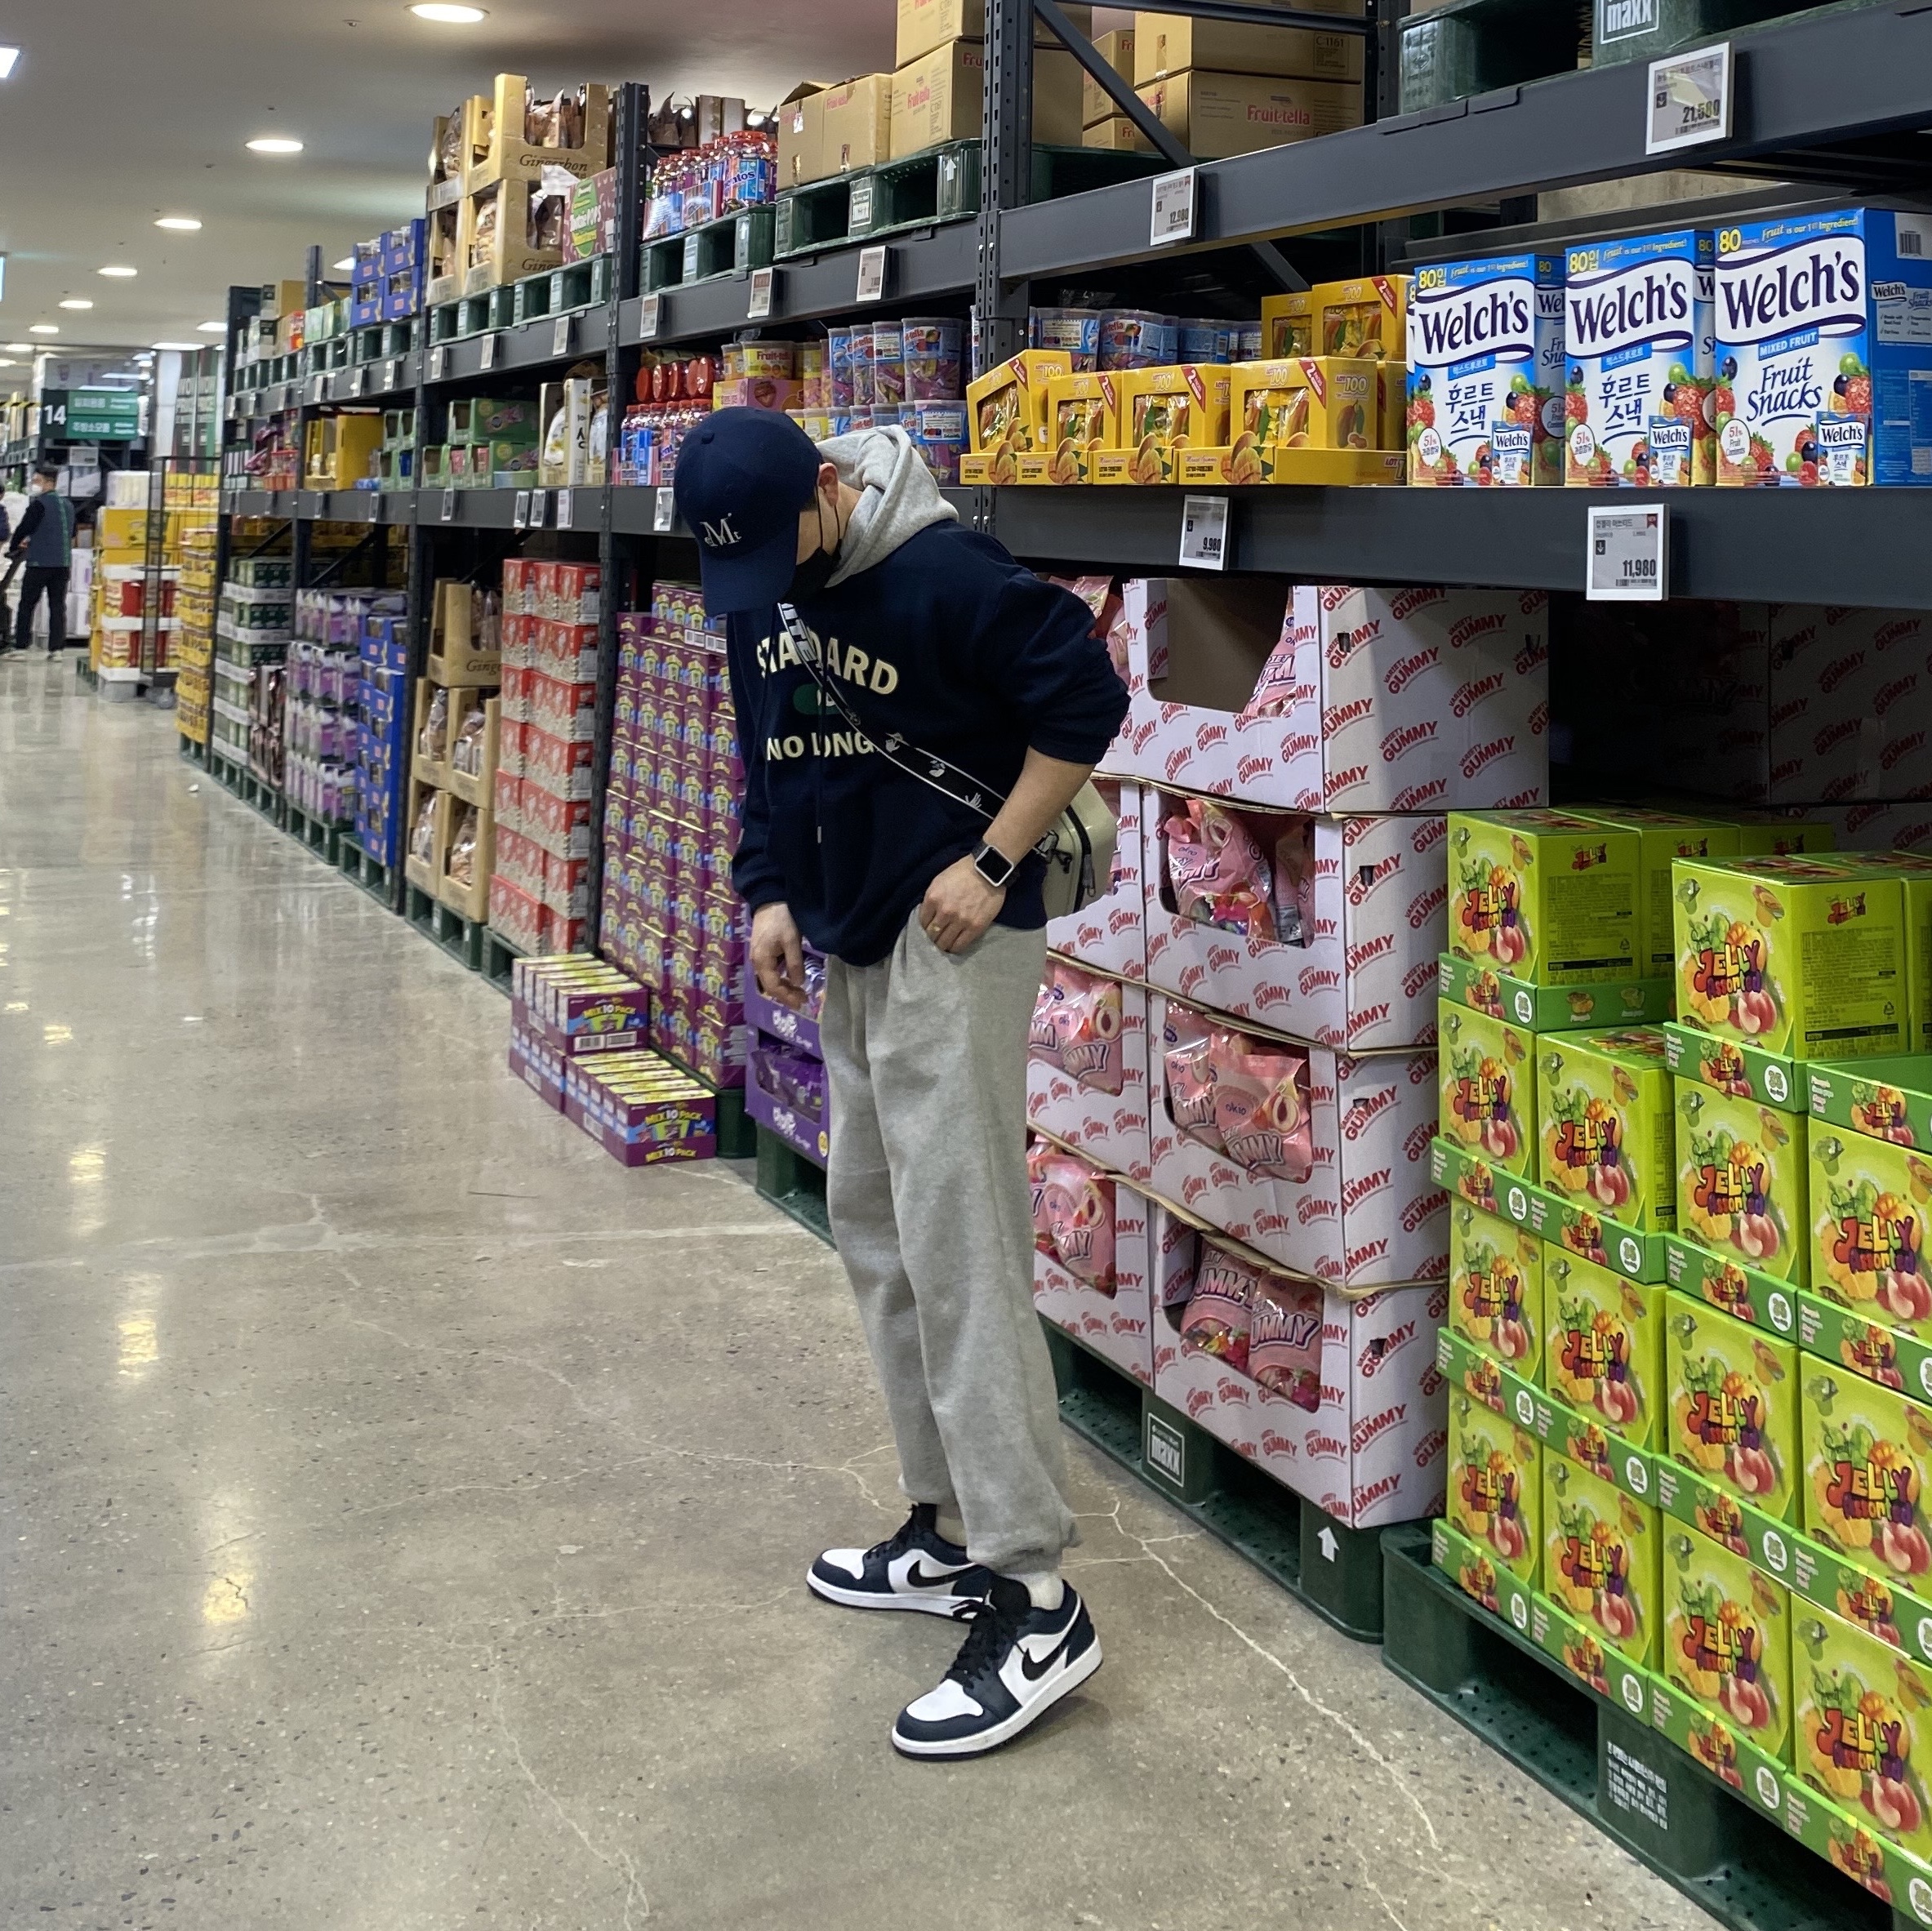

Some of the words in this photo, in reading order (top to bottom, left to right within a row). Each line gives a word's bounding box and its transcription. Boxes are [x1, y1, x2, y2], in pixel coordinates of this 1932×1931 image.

[1607, 0, 1652, 32] maxx
[1246, 104, 1310, 125] Fruit-tella
[1719, 229, 1742, 253] 80
[1538, 261, 1551, 273] 80
[1569, 248, 1600, 274] 80입
[1418, 269, 1446, 289] 80입
[1721, 251, 1860, 330] Welch's
[1873, 284, 1906, 298] Welch's
[1418, 291, 1529, 354] Welch's
[1569, 273, 1687, 345] Welch's
[1760, 341, 1787, 357] MIXED
[1789, 332, 1817, 349] FRUIT
[1044, 365, 1062, 377] 100
[1345, 376, 1368, 392] 100
[1761, 357, 1814, 394] Fruit
[1445, 383, 1495, 414] 후르트
[1599, 373, 1651, 408] 후르트
[1746, 382, 1823, 422] Snacks
[44, 405, 66, 425] 14
[1450, 405, 1486, 434] 스낵
[1605, 398, 1642, 430] 스낵
[1496, 433, 1528, 447] Welch's
[1654, 429, 1688, 445] Welch's
[1822, 425, 1863, 443] Welch's
[1203, 537, 1221, 551] 9,980
[1623, 559, 1656, 576] 11,980
[1392, 588, 1446, 621] GUMMY
[1450, 614, 1507, 649] GUMMY
[1383, 657, 1405, 683] VARIETY
[1387, 647, 1440, 695] GUMMY
[1449, 681, 1471, 707] VARIETY
[1453, 673, 1504, 719] GUMMY
[767, 736, 804, 761] NO
[1133, 719, 1157, 755] GUMMY
[1197, 726, 1226, 752] GUMMY
[1282, 735, 1319, 763] GUMMY
[1378, 726, 1404, 750] VARIETY
[1382, 720, 1438, 763] GUMMY
[1167, 745, 1191, 781] GUMMY
[1239, 757, 1273, 784] GUMMY
[1458, 744, 1482, 768] VARIETY
[1462, 736, 1515, 779] GUMMY
[1413, 819, 1448, 854] GUMM
[1409, 883, 1448, 929] GUMM
[1462, 882, 1516, 927] JELLY
[1109, 911, 1141, 934] GUMMY
[1209, 948, 1240, 972] GUMMY
[1694, 939, 1761, 993] JELLY
[1255, 986, 1291, 1010] GUMMY
[1299, 972, 1340, 996] GUMMY
[603, 1004, 614, 1013] 10
[1453, 1075, 1506, 1115] JELLY
[666, 1109, 679, 1120] 10
[665, 1147, 676, 1157] 10
[1555, 1117, 1617, 1160] JELLY
[1694, 1163, 1764, 1208] JELLY
[1298, 1199, 1338, 1225] GUMMY
[1402, 1192, 1449, 1233] GUMM
[1834, 1215, 1915, 1264] JELLY
[1464, 1271, 1518, 1309] JELLY
[1561, 1329, 1624, 1370] JELLY
[1687, 1390, 1758, 1435] JELLY
[1262, 1435, 1298, 1457] GUMMY
[1307, 1437, 1347, 1458] GUMMY
[1462, 1464, 1515, 1502] JELLY
[1826, 1461, 1912, 1508] JELLY
[1560, 1537, 1623, 1577] JELLY
[1683, 1615, 1754, 1659] JELLY
[1816, 1708, 1902, 1756] JELLY
